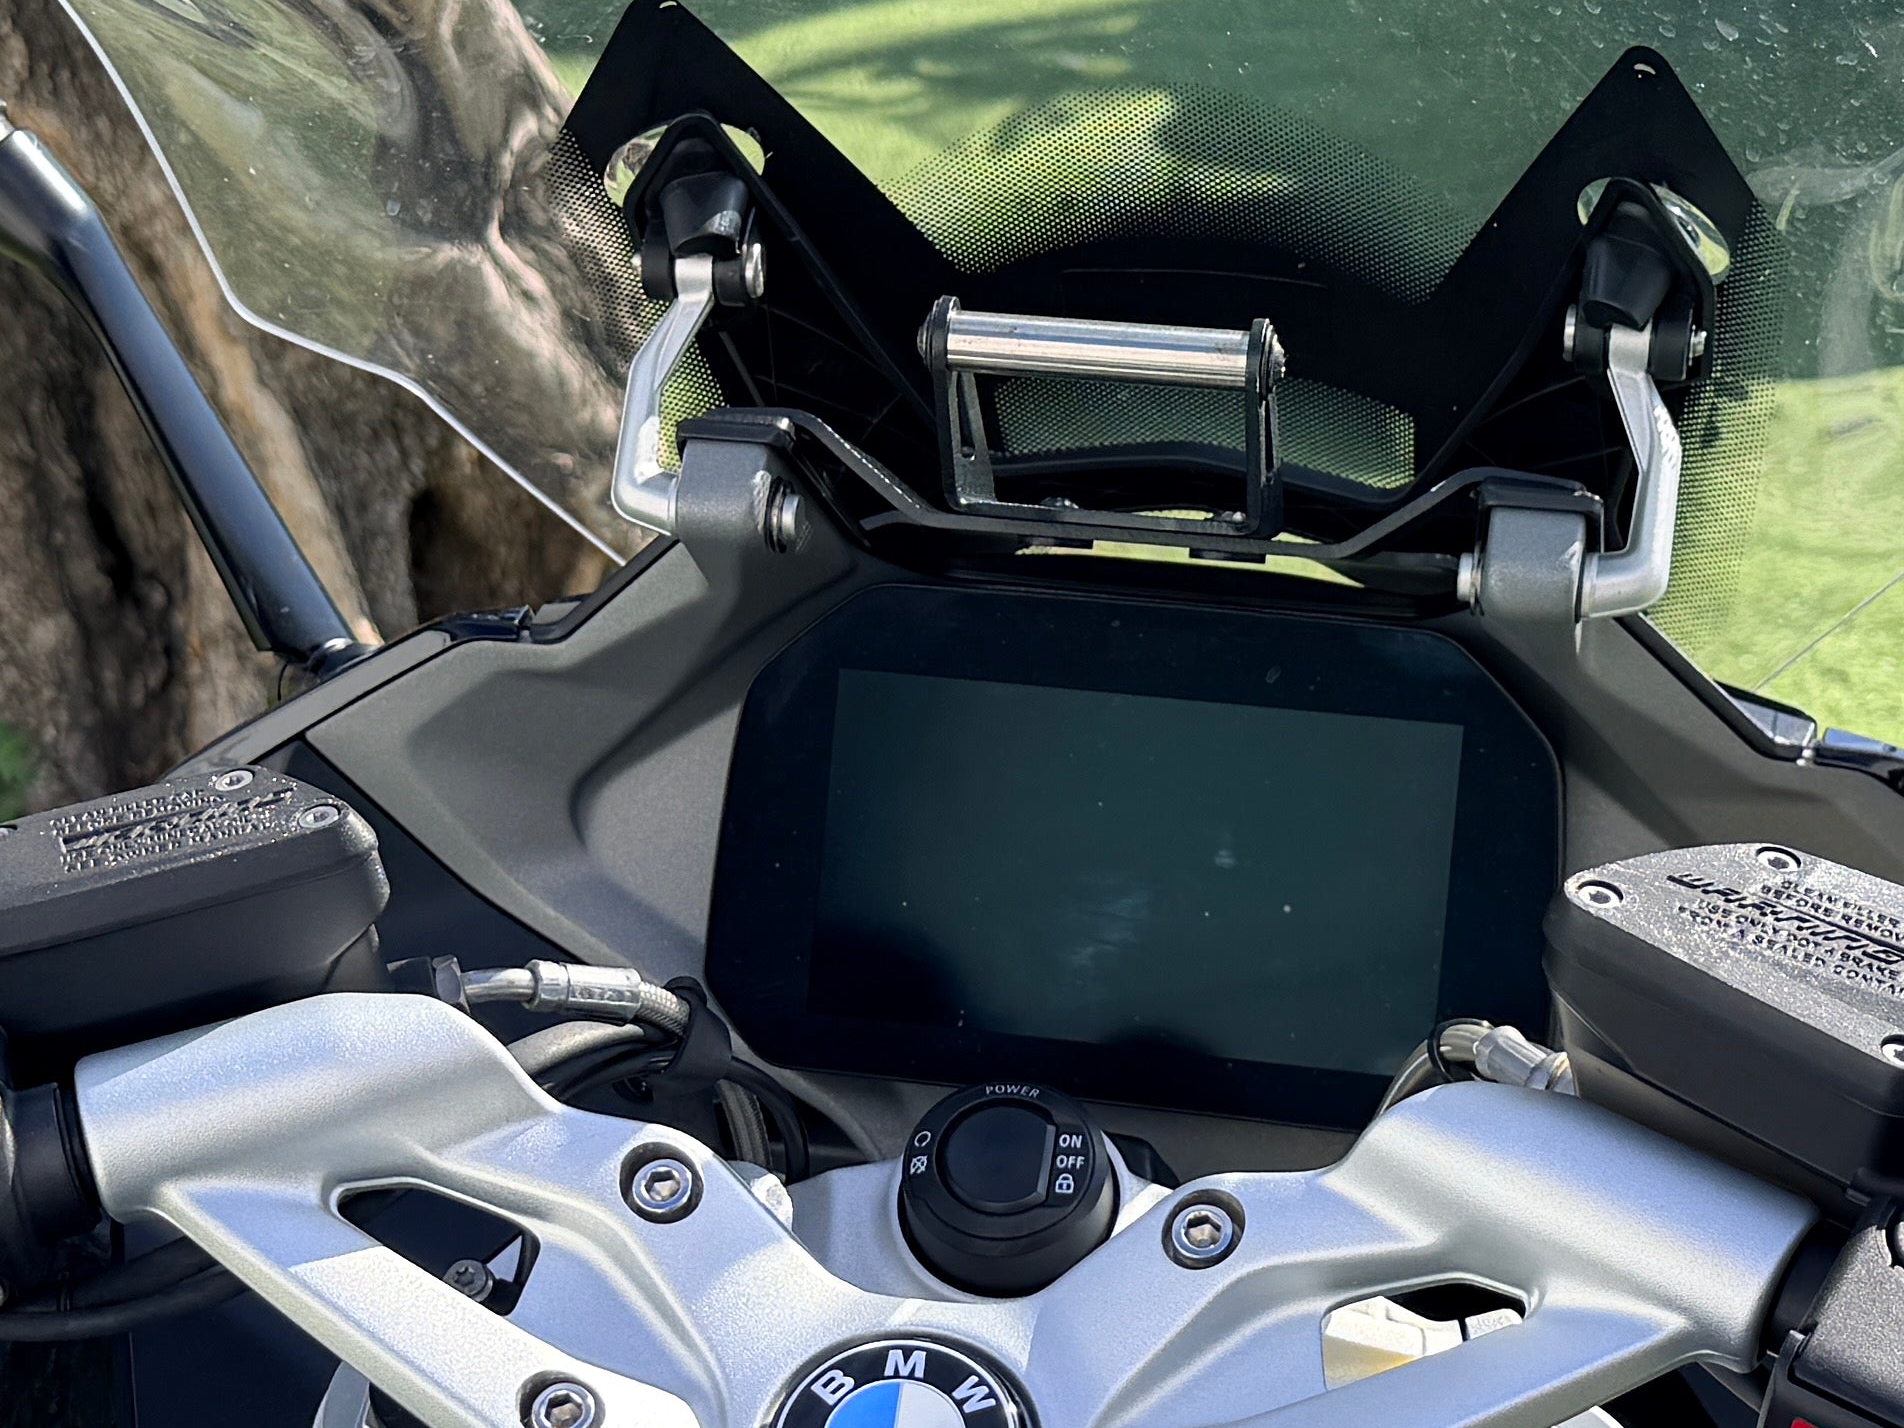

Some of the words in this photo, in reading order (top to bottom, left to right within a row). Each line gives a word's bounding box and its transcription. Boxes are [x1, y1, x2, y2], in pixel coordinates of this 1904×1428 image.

[985, 1084, 1040, 1097] POWER
[1059, 1134, 1082, 1149] ON
[1056, 1155, 1085, 1169] OFF
[811, 1349, 996, 1414] BMW
